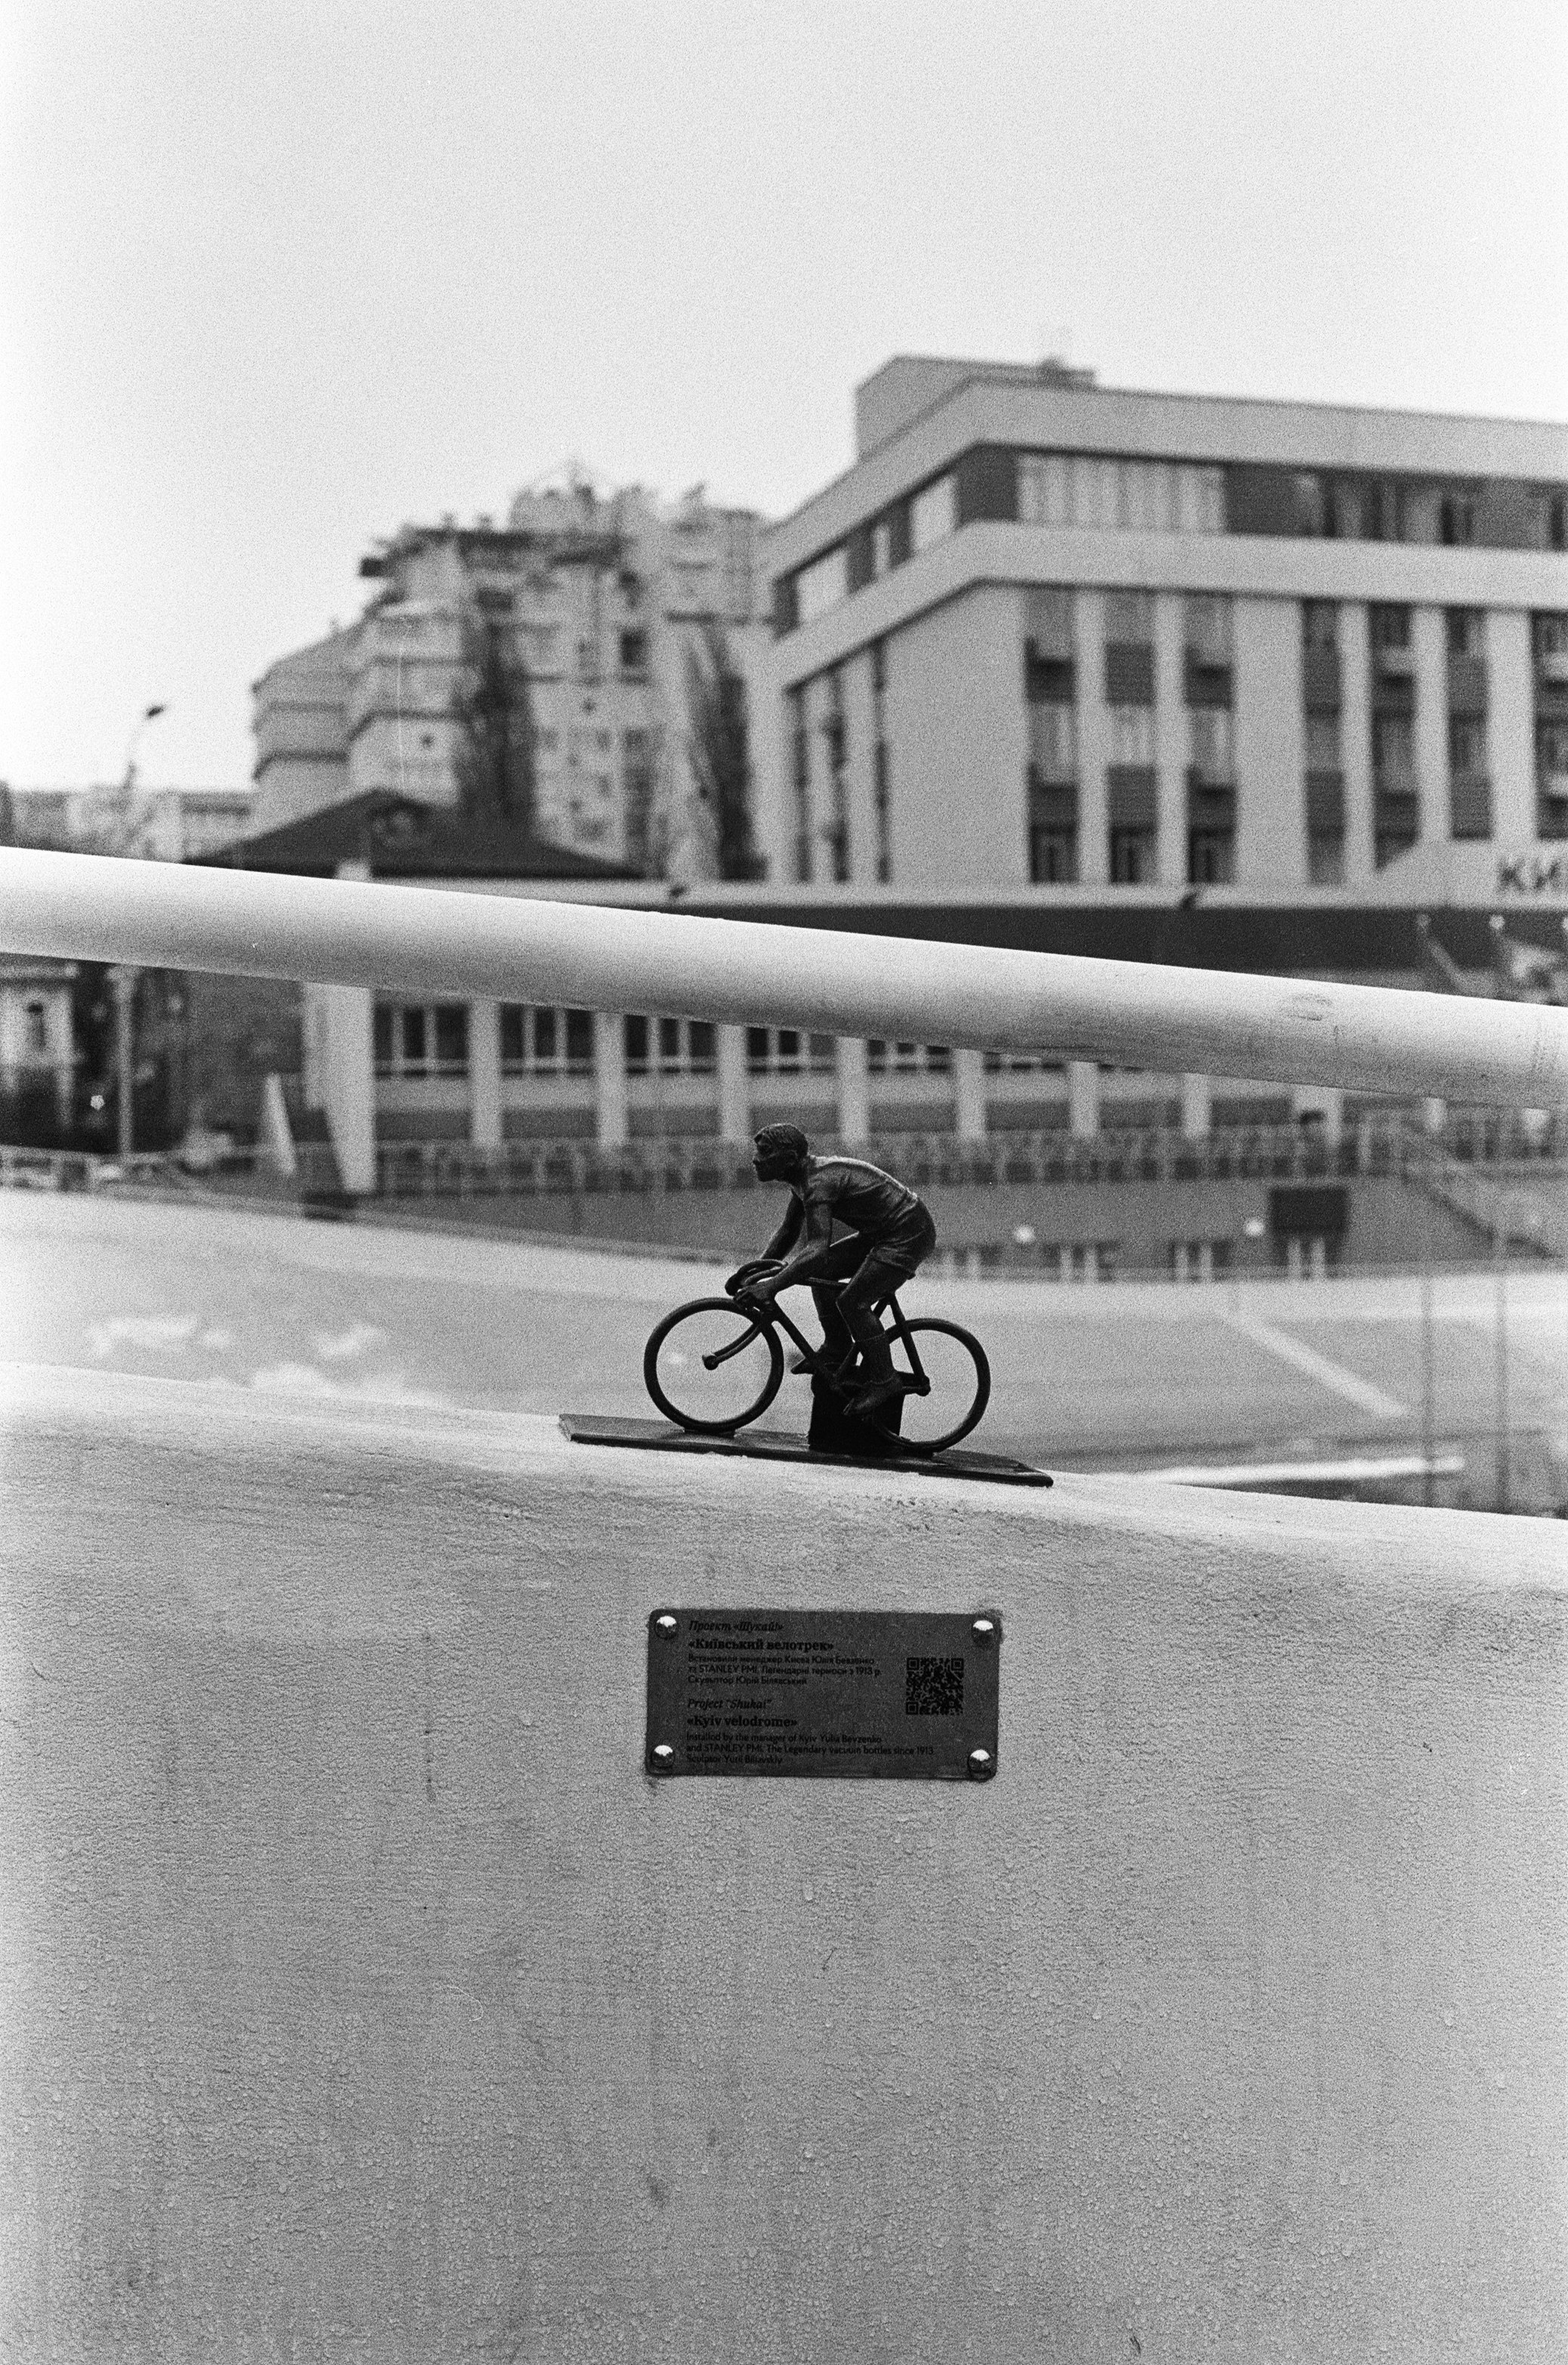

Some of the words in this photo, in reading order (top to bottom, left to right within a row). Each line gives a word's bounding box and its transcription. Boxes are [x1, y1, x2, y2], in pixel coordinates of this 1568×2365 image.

[688, 1620, 731, 1633] Проект
[688, 1638, 763, 1650] «Київський
[767, 1640, 834, 1652] велотрек»
[699, 1665, 740, 1674] STANLEY
[855, 1666, 873, 1676] 1913
[688, 1698, 723, 1710] Project
[687, 1714, 722, 1728] «Kyiv
[725, 1714, 798, 1727] velodrome»
[687, 1732, 721, 1742] Installed
[722, 1733, 733, 1743] by
[735, 1733, 749, 1742] the
[751, 1736, 786, 1745] manager
[788, 1733, 797, 1742] of
[799, 1733, 817, 1745] Kyiv
[842, 1734, 882, 1744] Bevzenko
[686, 1744, 702, 1752] and
[704, 1744, 744, 1752] STANLEY
[767, 1744, 783, 1754] The
[785, 1745, 827, 1756] Legendary
[863, 1745, 892, 1755] bottles
[893, 1746, 914, 1755] since
